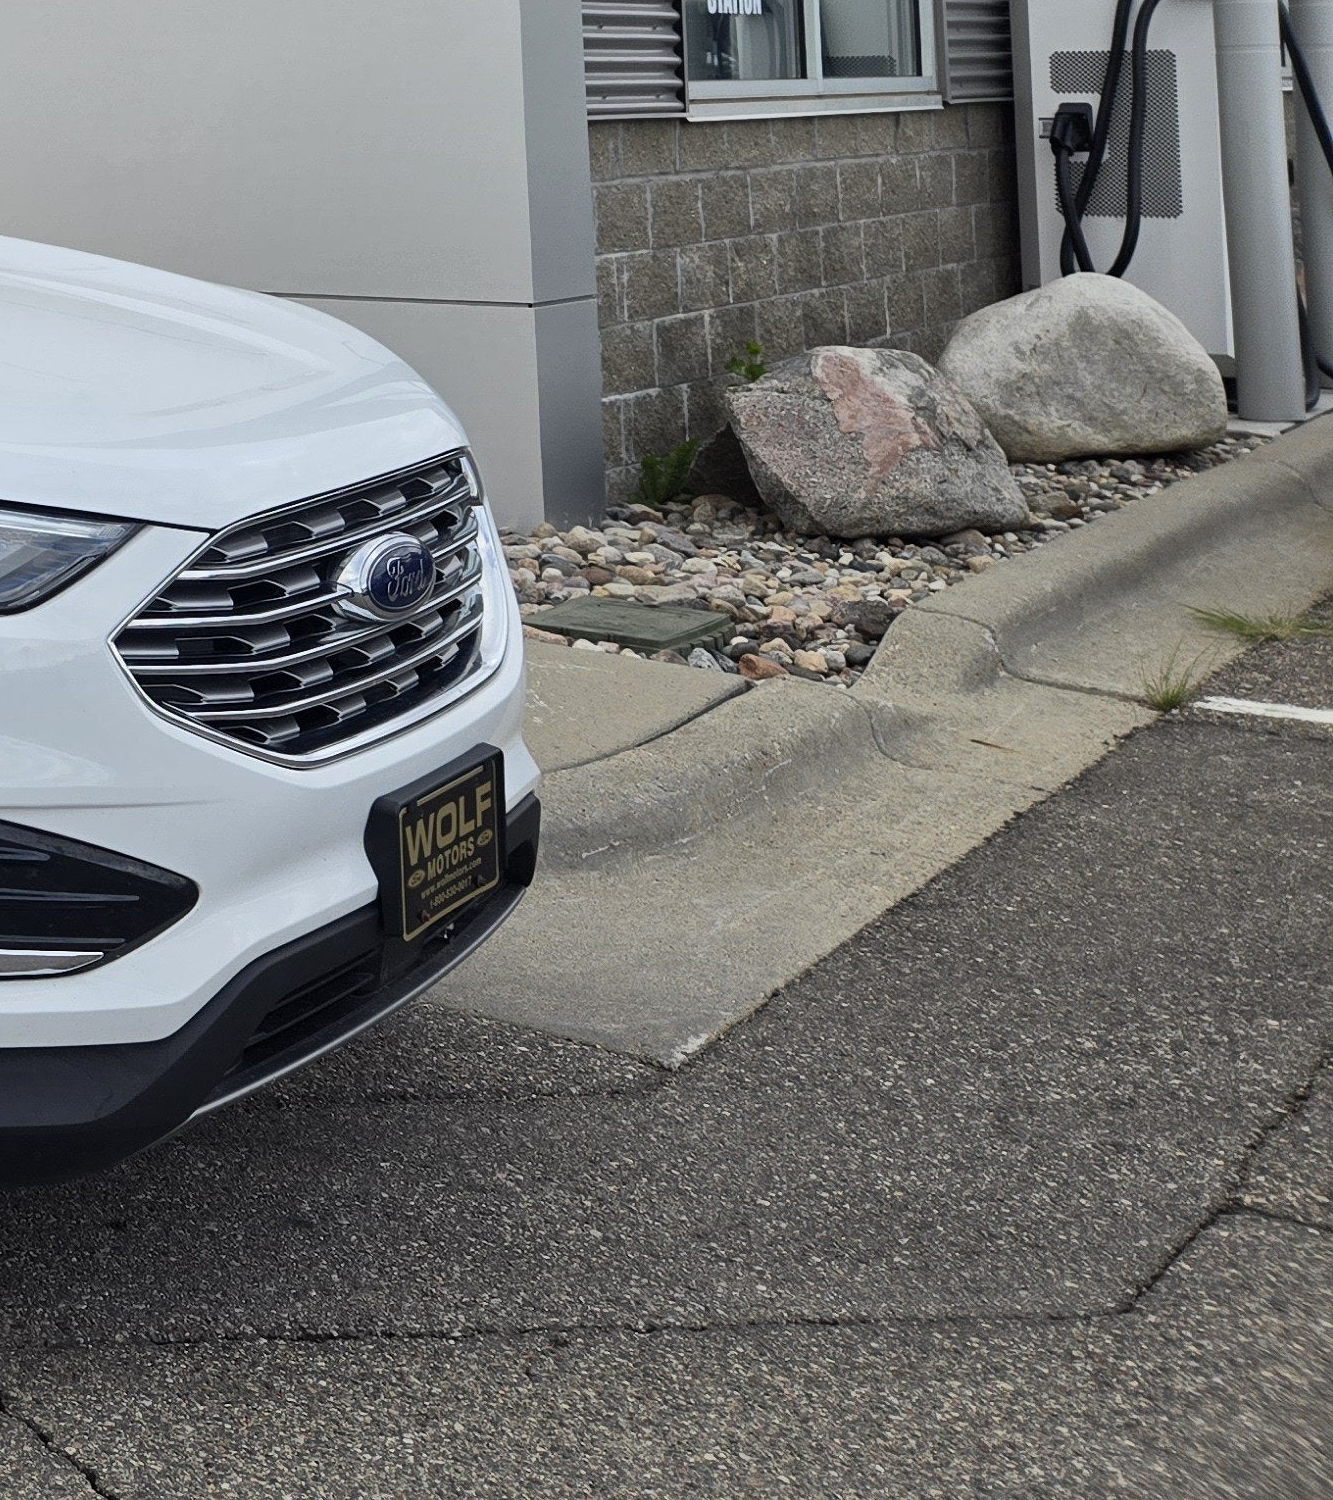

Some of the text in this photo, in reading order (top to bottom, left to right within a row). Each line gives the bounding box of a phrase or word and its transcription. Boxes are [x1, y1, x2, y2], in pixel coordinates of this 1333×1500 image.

[387, 553, 427, 602] Ford
[405, 781, 492, 867] WOLF
[427, 836, 475, 881] MOTORS
